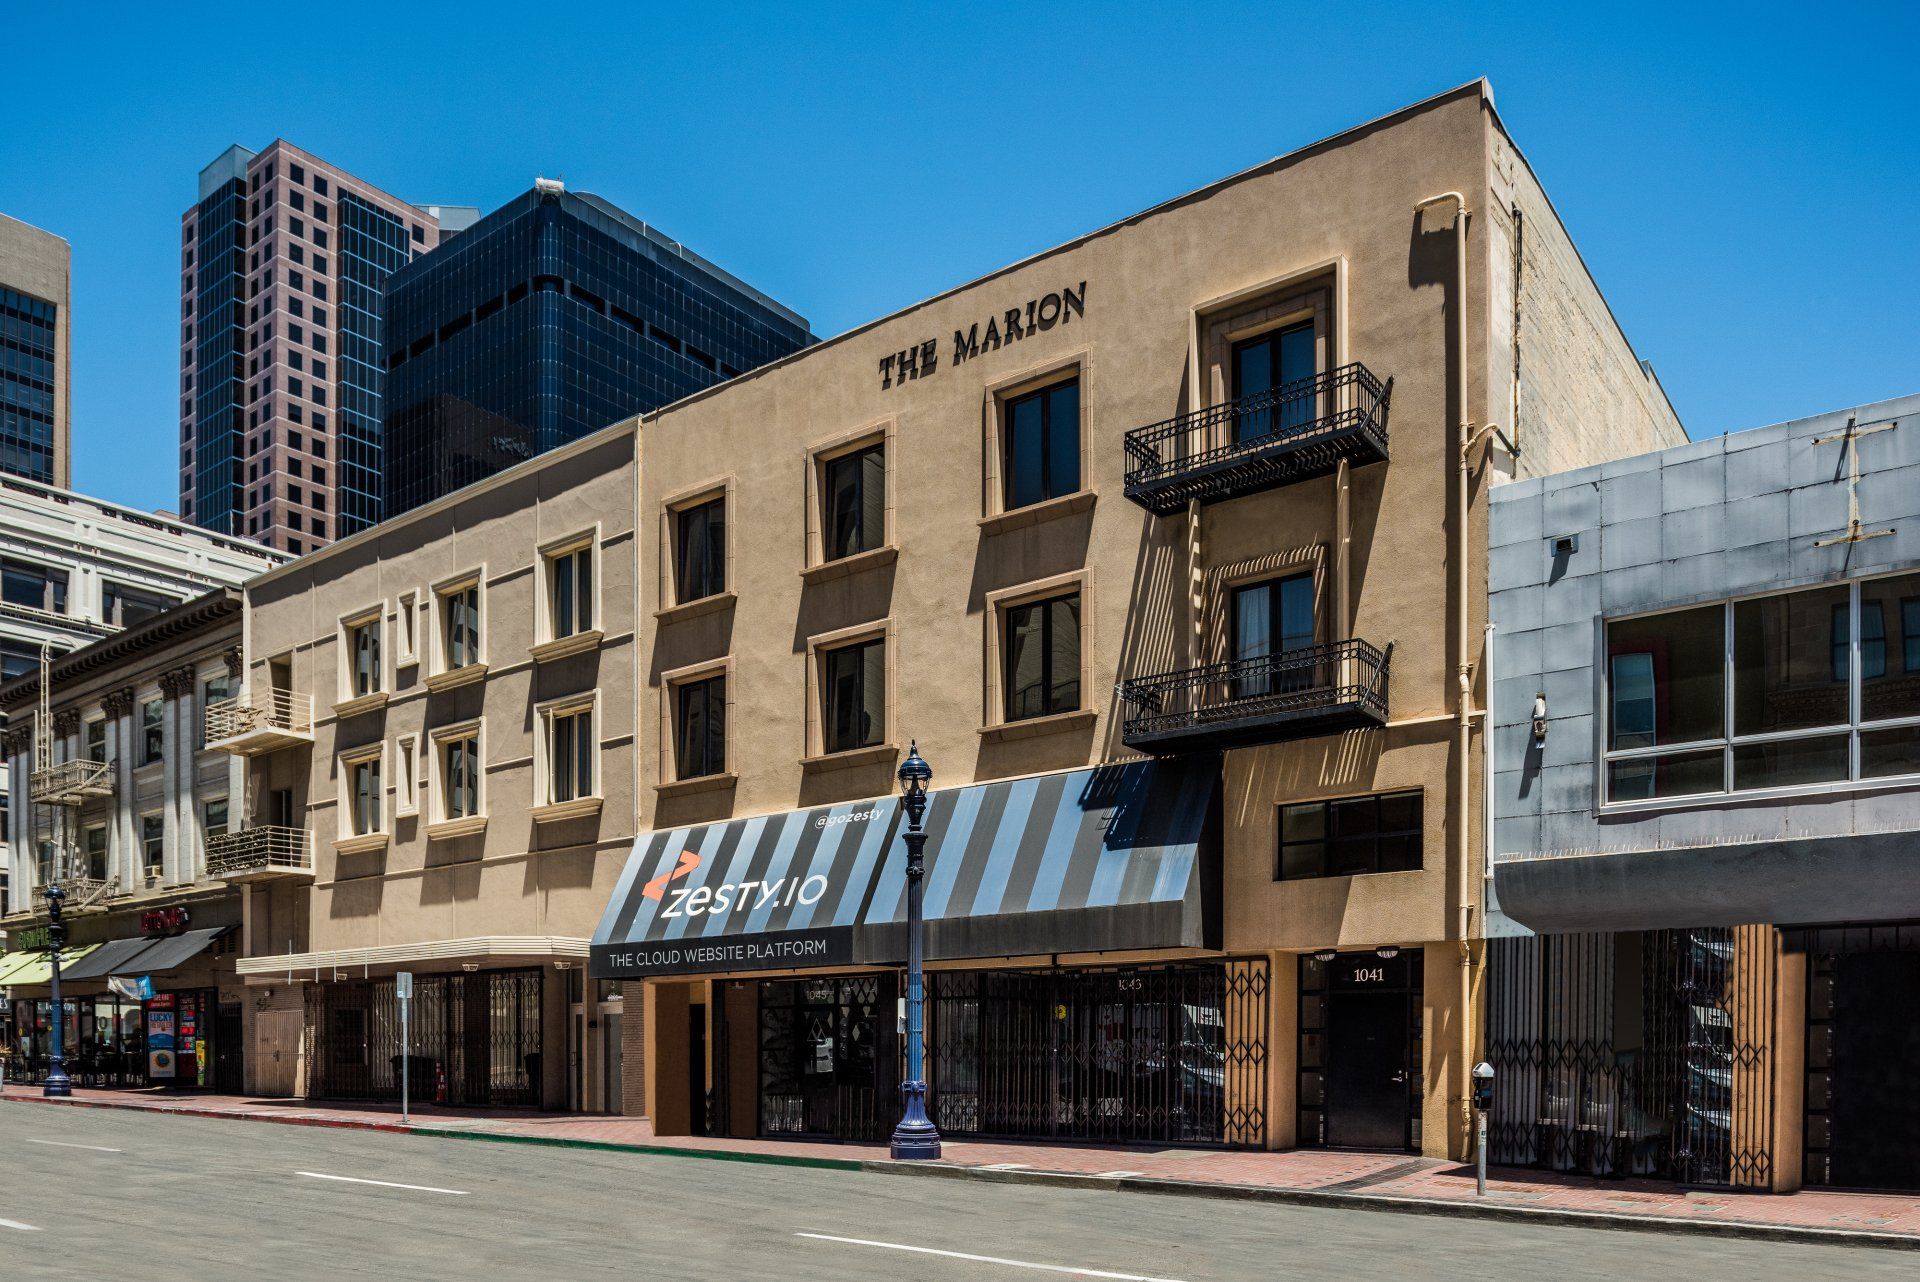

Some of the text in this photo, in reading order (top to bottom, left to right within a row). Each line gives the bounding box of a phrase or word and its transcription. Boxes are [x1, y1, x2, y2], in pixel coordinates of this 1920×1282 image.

[879, 281, 1087, 384] THE MARION
[814, 808, 884, 829] @gozesty
[609, 939, 827, 968] THE CLOUD WEBSITE PLATFORM
[1353, 968, 1385, 982] 1041
[806, 990, 827, 1000] 1045
[150, 1013, 172, 1022] LUCKY
